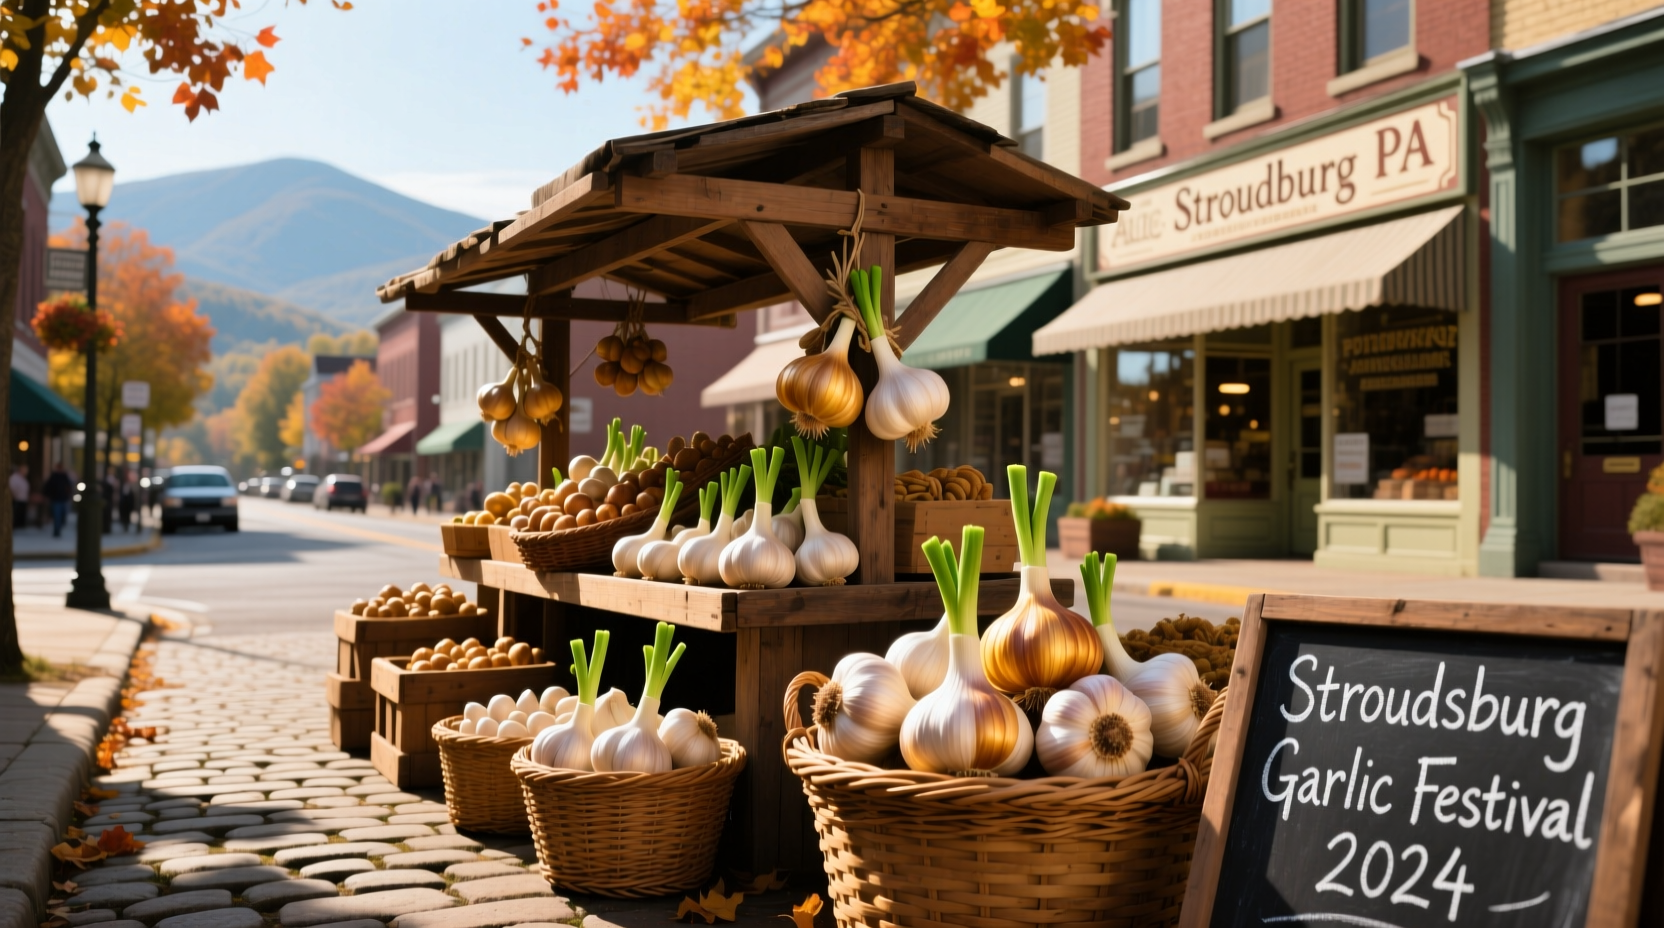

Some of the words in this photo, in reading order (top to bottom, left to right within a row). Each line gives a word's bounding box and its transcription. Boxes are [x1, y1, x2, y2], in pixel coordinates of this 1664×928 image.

[1174, 154, 1358, 232] Stroudburg
[1374, 119, 1435, 180] PA
[1279, 654, 1587, 773] Stroudsburg
[1261, 737, 1393, 821] Garlic
[1409, 756, 1595, 850] Festival
[1315, 831, 1475, 922] 2024
